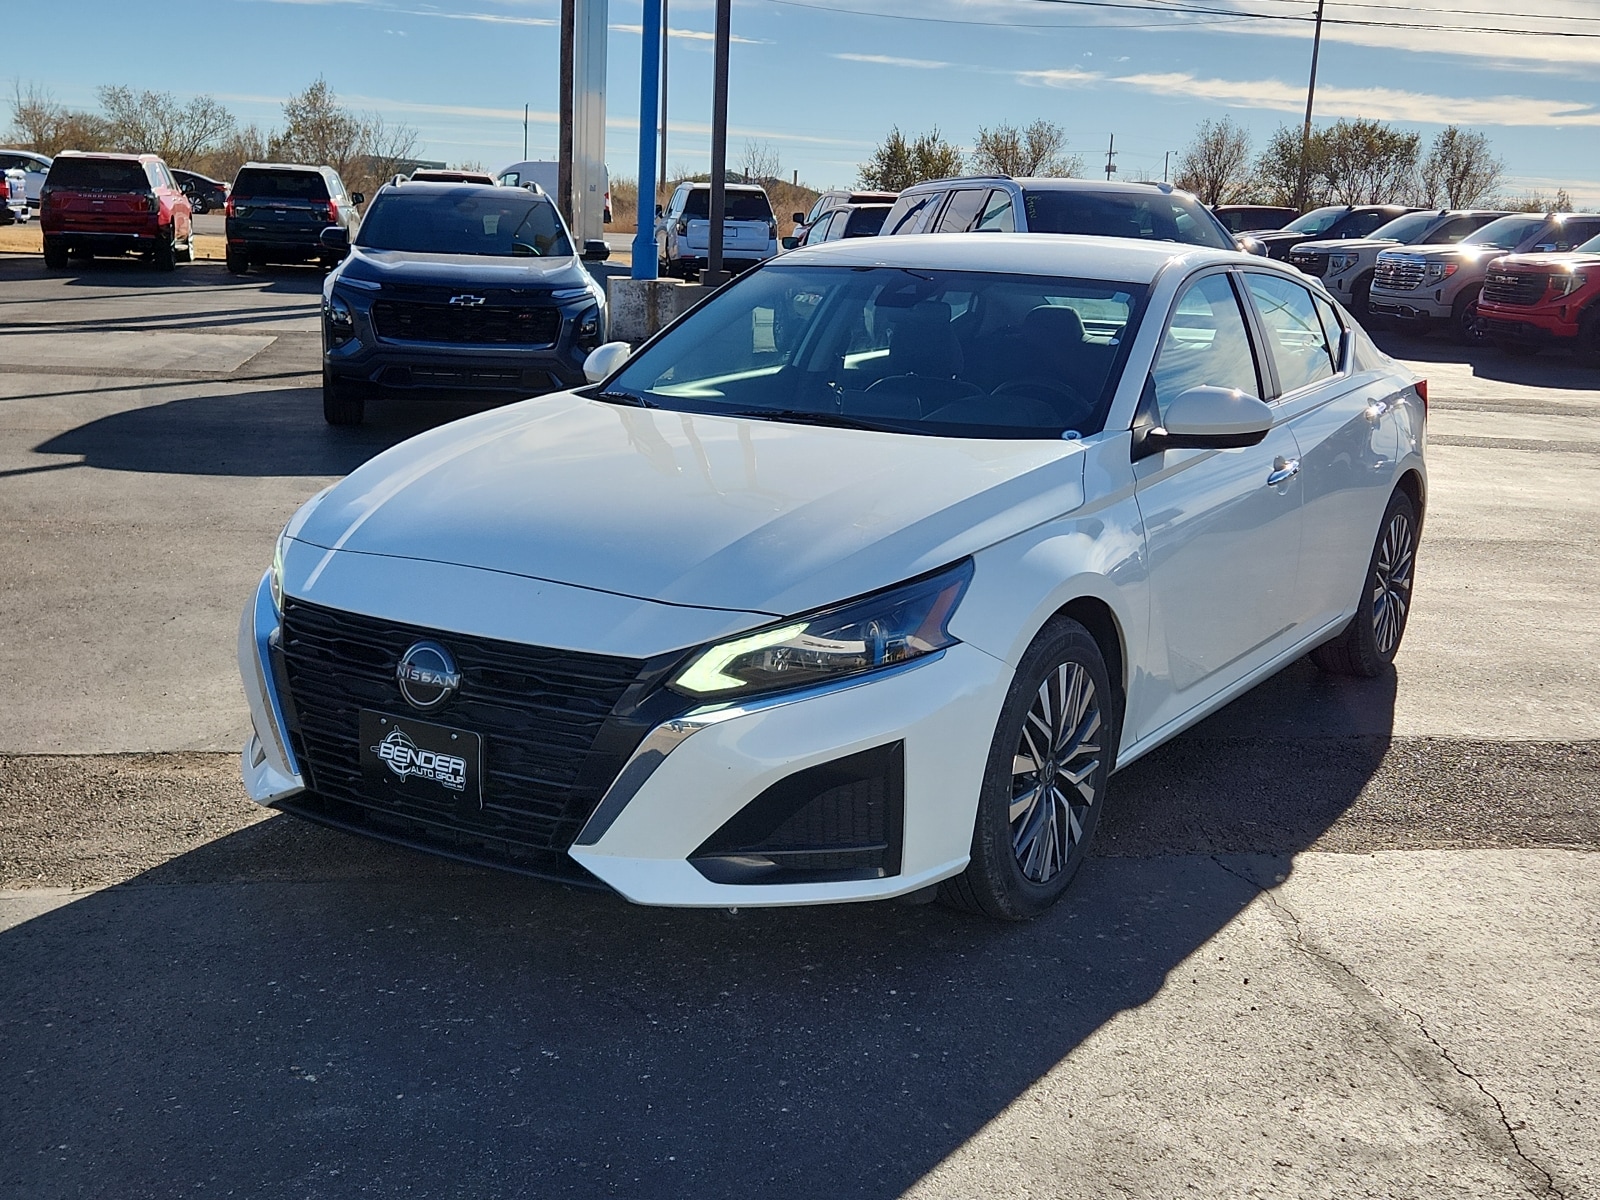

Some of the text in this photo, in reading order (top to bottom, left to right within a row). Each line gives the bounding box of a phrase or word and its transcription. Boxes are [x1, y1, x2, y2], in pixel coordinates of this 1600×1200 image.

[397, 666, 460, 687] NISSAN
[379, 742, 465, 775] BENDER
[411, 766, 465, 784] AUTO GROUP
